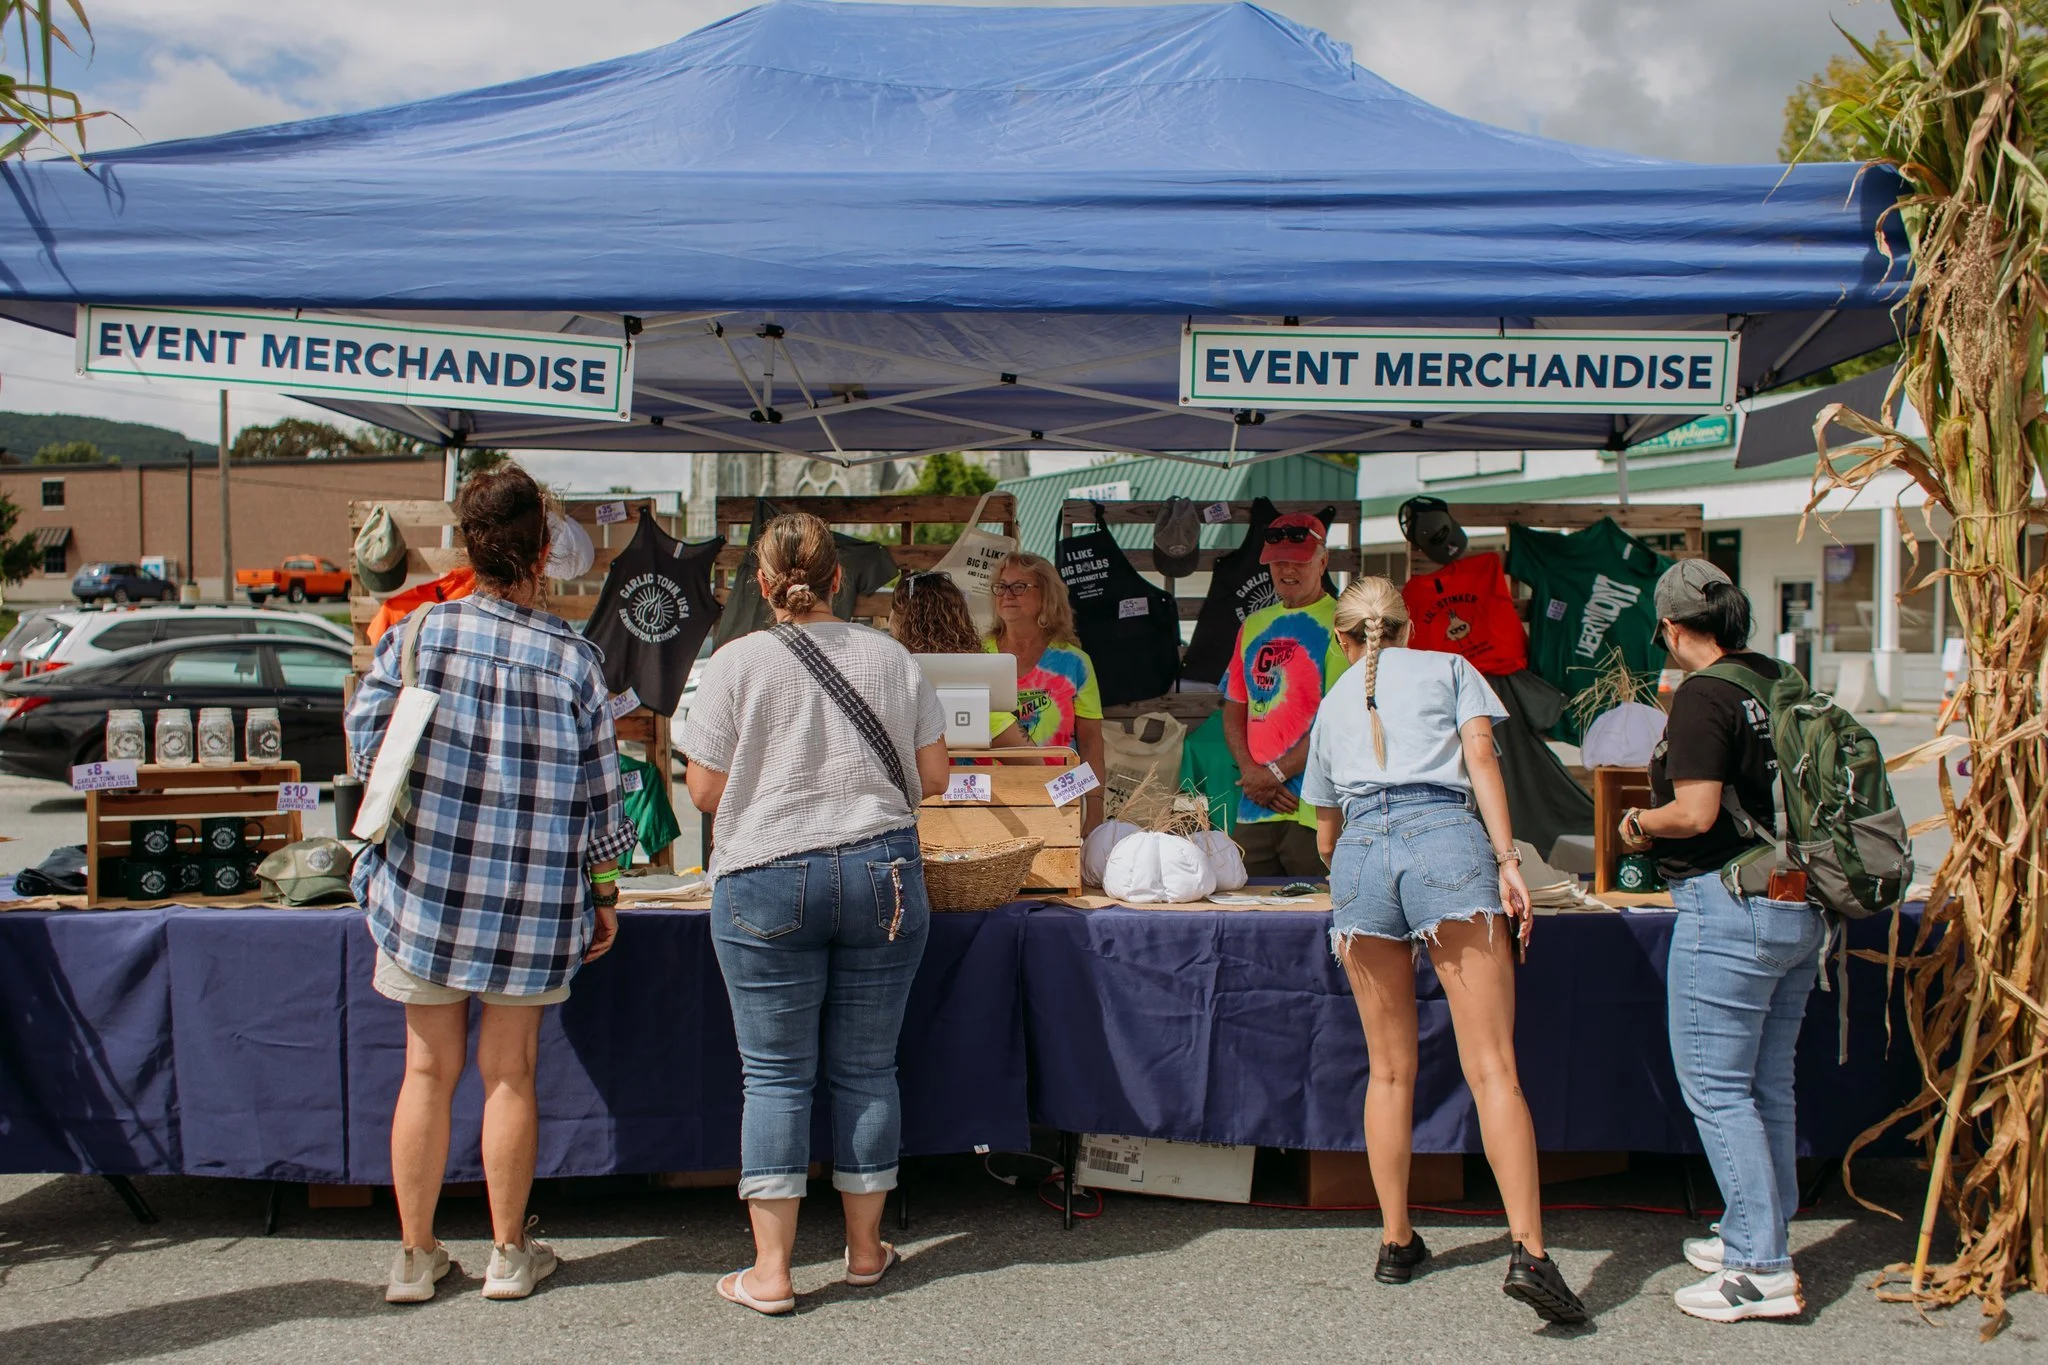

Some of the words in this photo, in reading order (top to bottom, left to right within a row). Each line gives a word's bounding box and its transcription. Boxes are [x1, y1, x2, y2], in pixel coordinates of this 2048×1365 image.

[100, 322, 246, 365] EVENT
[261, 333, 607, 395] MERCHANDISE
[1205, 348, 1358, 386] EVENT
[1374, 351, 1713, 390] MERCHANDISE
[966, 556, 981, 568] BIG
[1066, 552, 1072, 562] I
[1071, 548, 1095, 560] LIKE
[1060, 565, 1075, 578] BIG
[1235, 571, 1270, 599] GARLIC
[620, 573, 654, 599] GARLIC
[656, 574, 682, 599] TOWN,
[677, 597, 691, 619] USA
[1574, 573, 1641, 659] VERMONT
[1256, 675, 1275, 686] TOWN
[963, 774, 977, 787] $8
[1053, 772, 1075, 792] $35
[284, 785, 309, 797] $10
